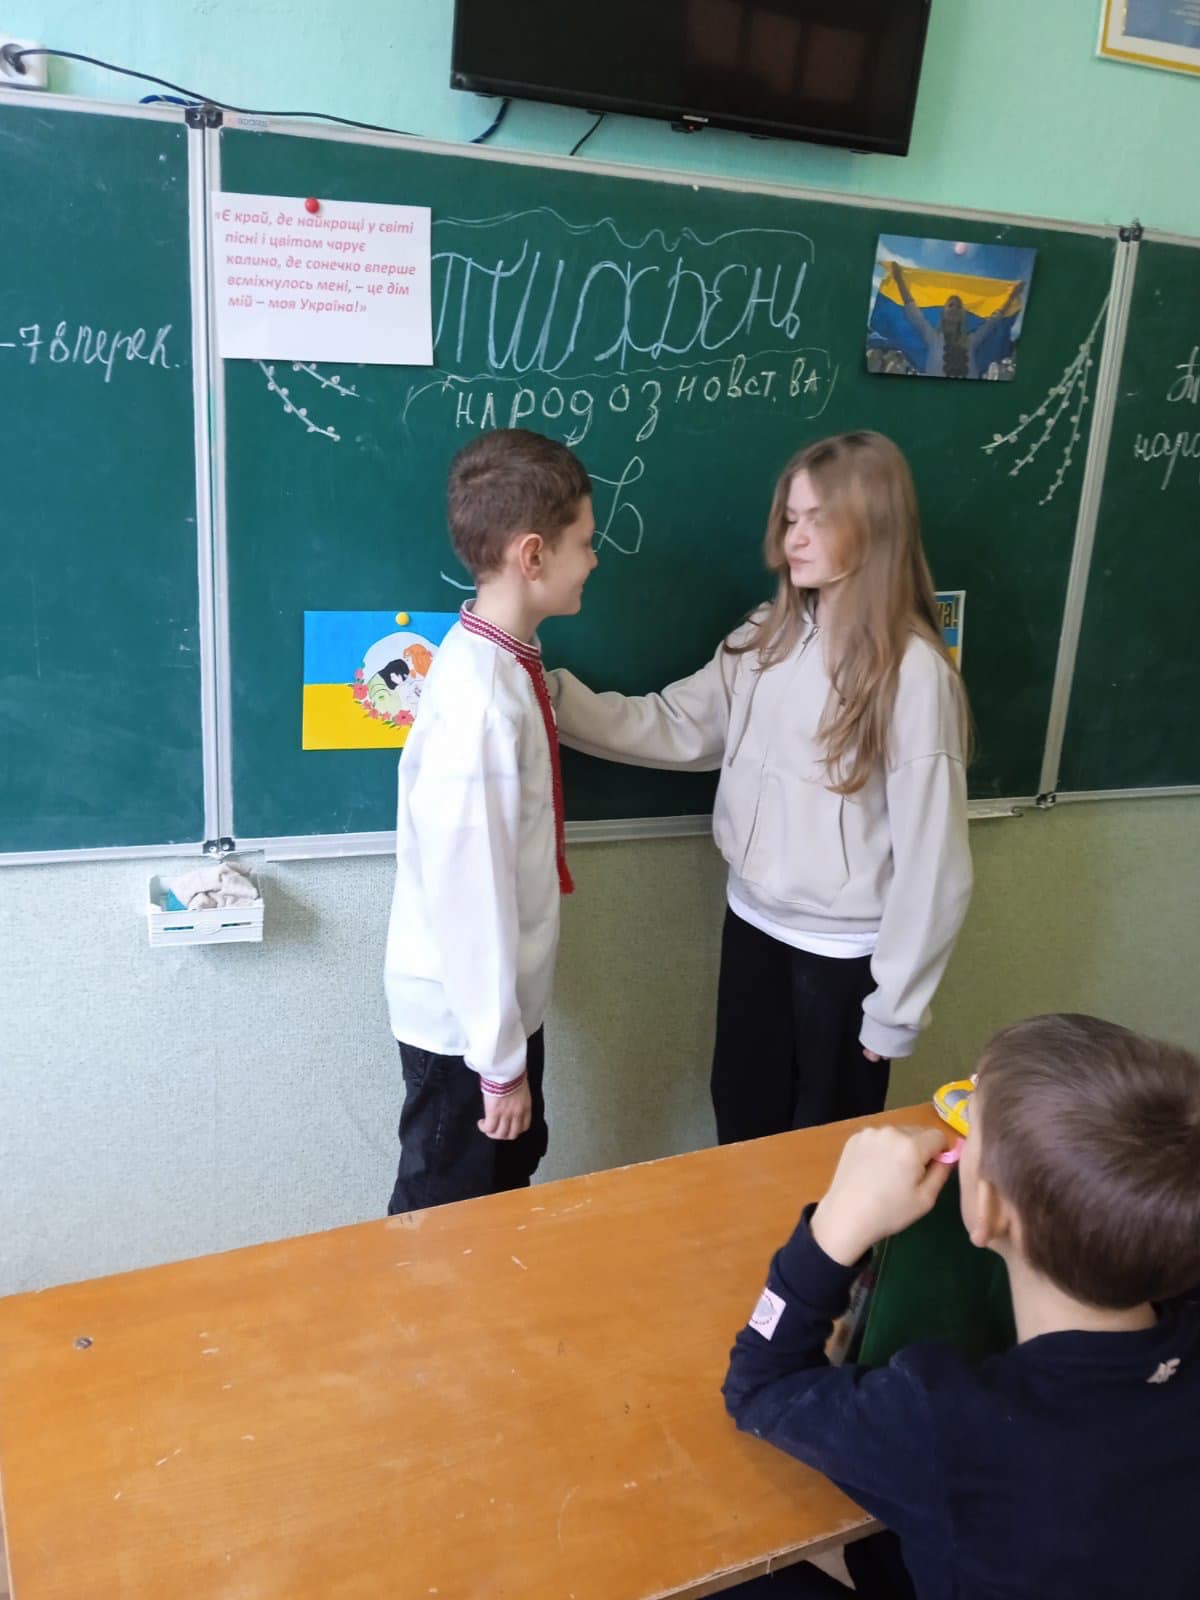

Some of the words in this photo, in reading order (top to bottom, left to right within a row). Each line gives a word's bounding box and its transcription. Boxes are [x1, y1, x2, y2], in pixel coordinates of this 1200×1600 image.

[235, 211, 272, 226] край,
[277, 212, 294, 226] де
[298, 215, 365, 232] найкращі
[368, 222, 376, 233] у
[379, 221, 415, 234] світі
[225, 232, 258, 245] пісні
[262, 233, 267, 245] і
[269, 235, 323, 248] цвітом
[327, 241, 367, 253] чарує
[226, 255, 281, 268] калина,
[286, 256, 302, 269] де
[306, 259, 361, 272] сонечко
[365, 263, 417, 276] вперше
[227, 275, 313, 291] всміхнулось
[317, 279, 352, 293] мені,
[368, 284, 384, 296] це
[387, 282, 410, 295] дім
[228, 295, 253, 308] мій
[268, 299, 296, 309] моя
[300, 298, 367, 313] Україна!»
